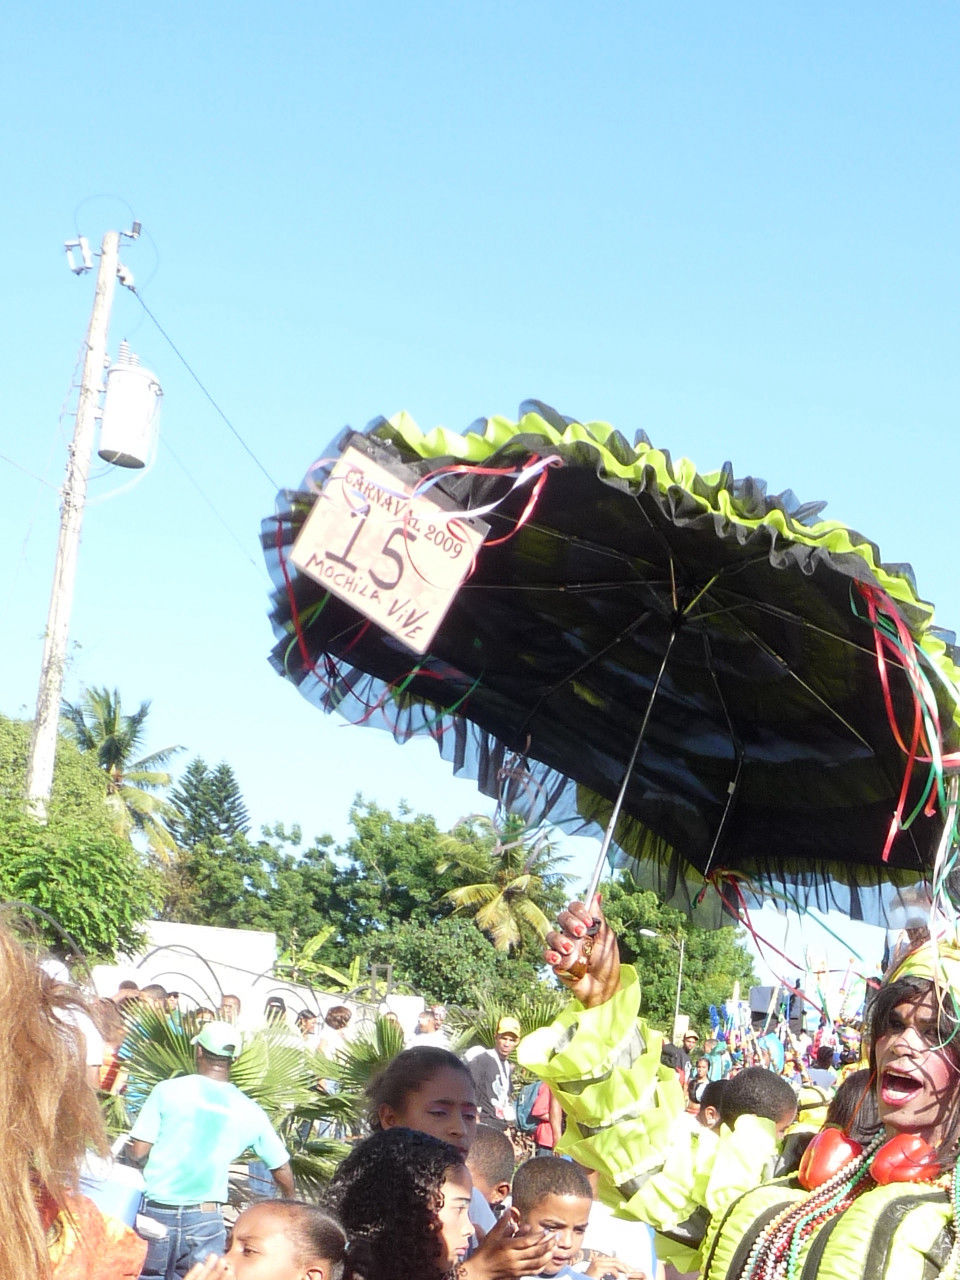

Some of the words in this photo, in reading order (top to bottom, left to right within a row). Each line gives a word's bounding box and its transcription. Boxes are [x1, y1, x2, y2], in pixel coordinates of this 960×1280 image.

[325, 504, 418, 591] 15
[345, 473, 419, 532] CARNAVAL
[424, 525, 464, 560] 2009
